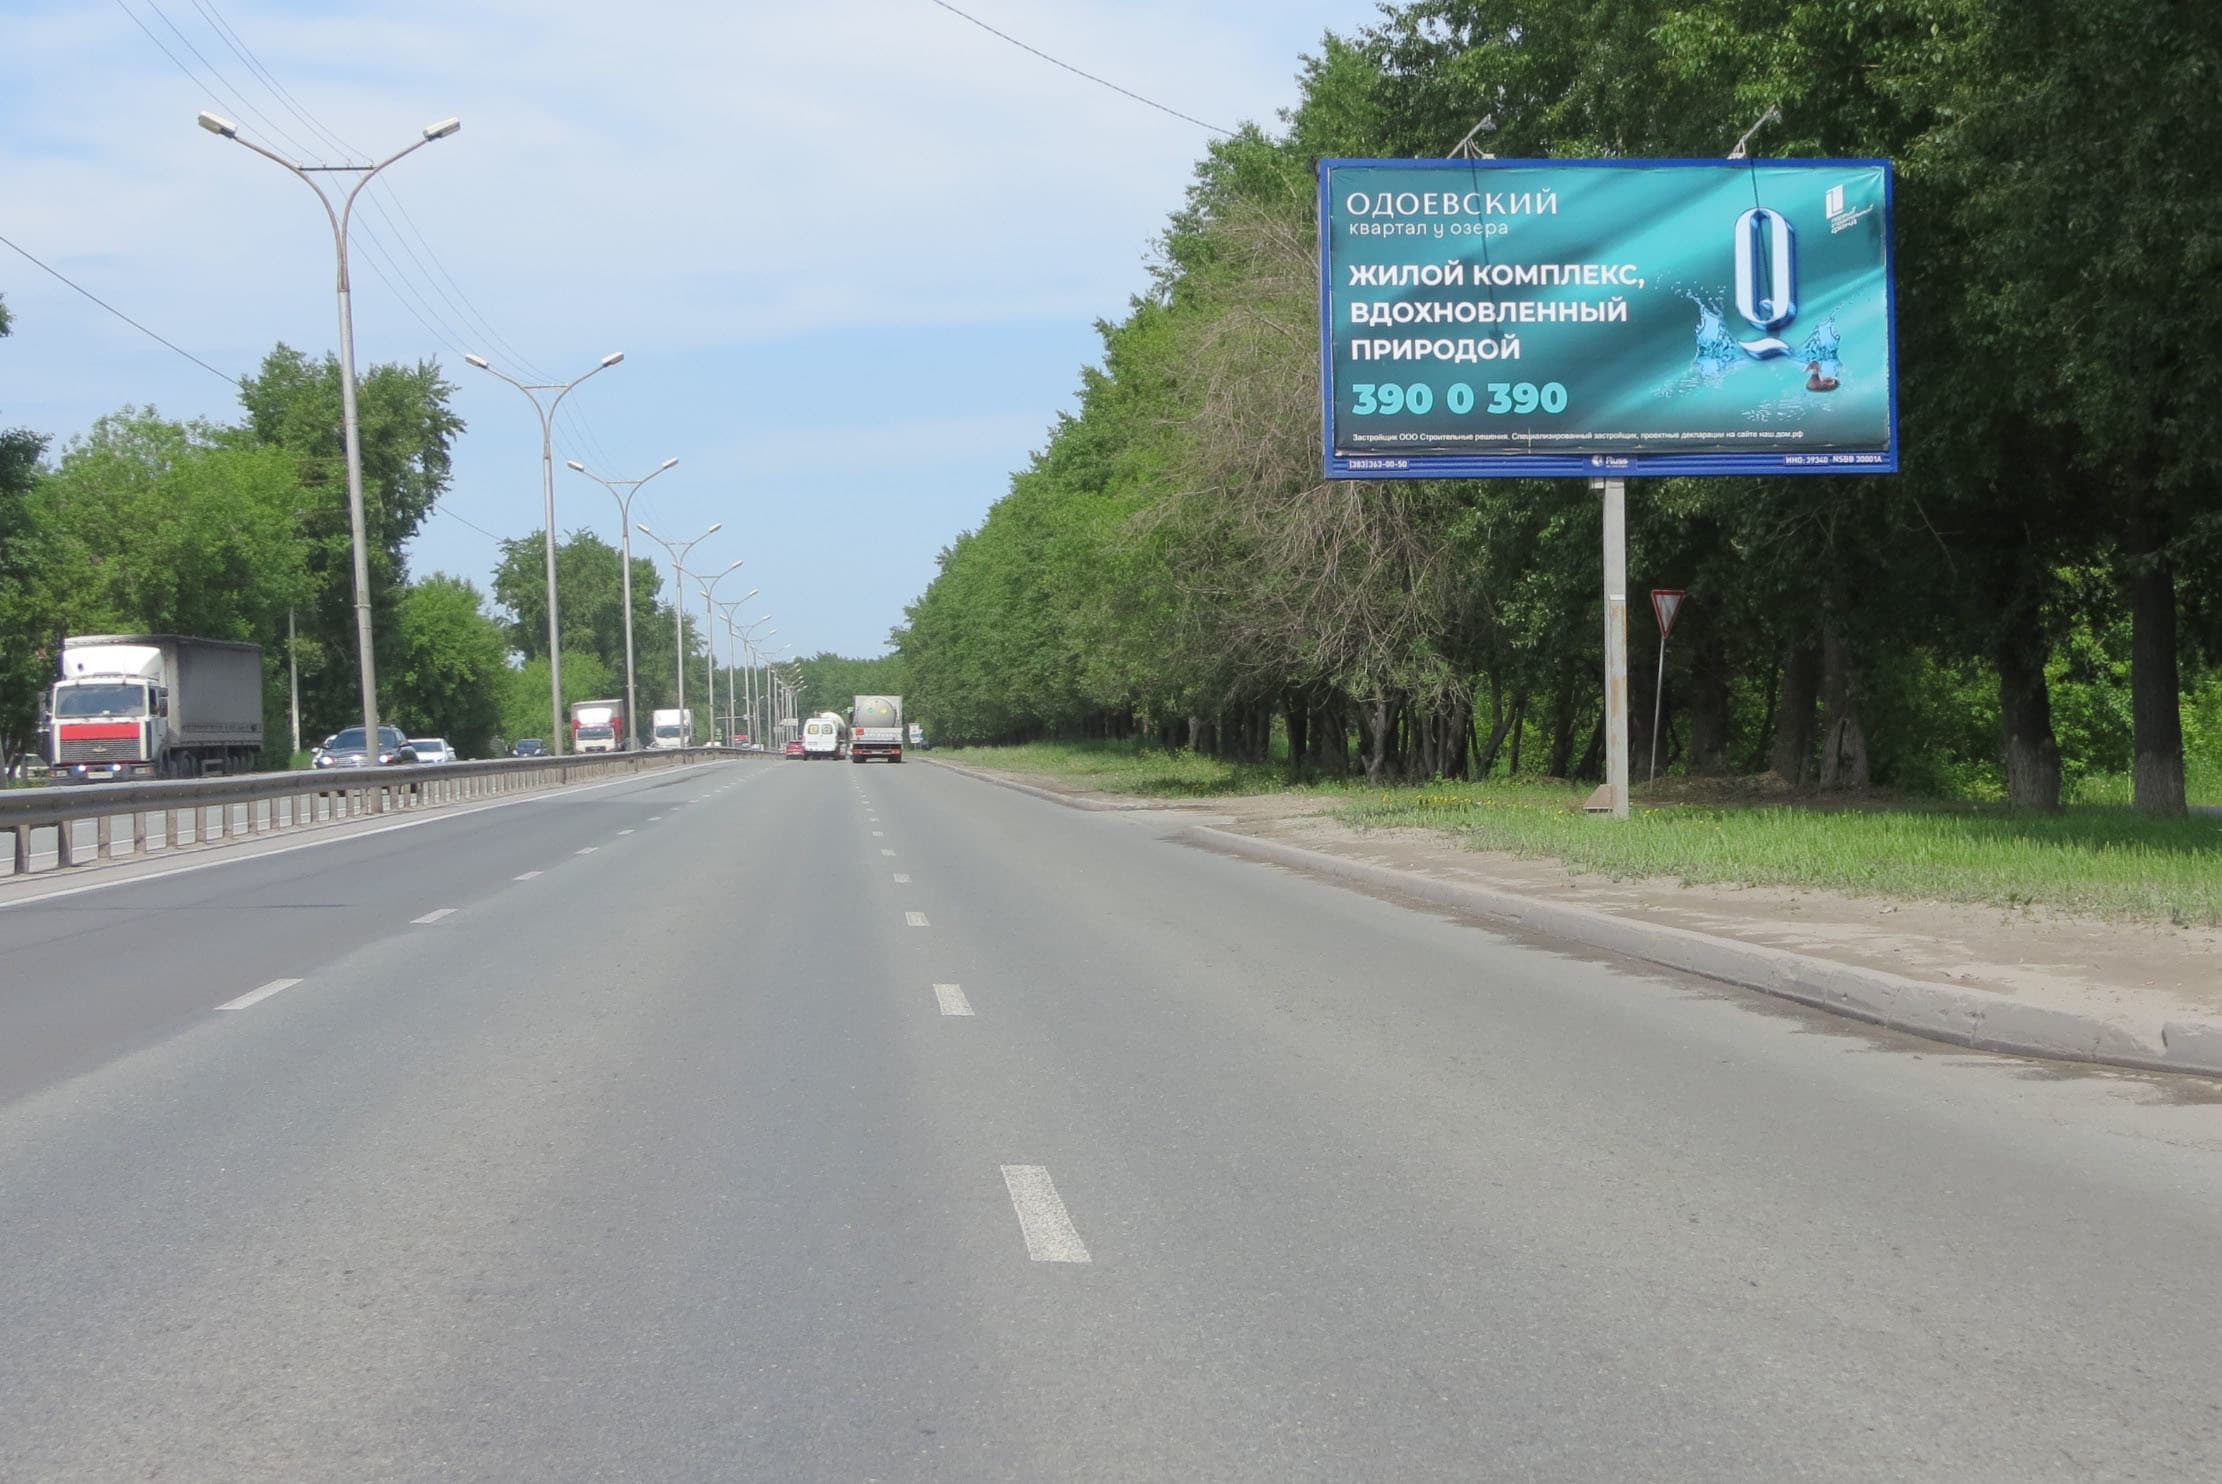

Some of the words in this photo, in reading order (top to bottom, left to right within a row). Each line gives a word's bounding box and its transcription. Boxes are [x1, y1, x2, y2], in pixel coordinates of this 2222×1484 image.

[1346, 187, 1558, 218] ОДОЕВСКИЙ
[1349, 222, 1427, 238] квартал
[1433, 222, 1444, 238] у
[1450, 222, 1509, 237] озера
[1348, 259, 1464, 286] ЖИЛОЙ
[1473, 264, 1646, 289] КОМПЛЕКС,
[1350, 296, 1628, 327] ВДОХНОВЛЕННЫЙ
[1351, 333, 1521, 363] ПРИРОДОЙ
[1352, 383, 1434, 415] 390
[1447, 383, 1475, 415] 0
[1487, 382, 1568, 414] 390
[1399, 433, 1418, 441] ООО
